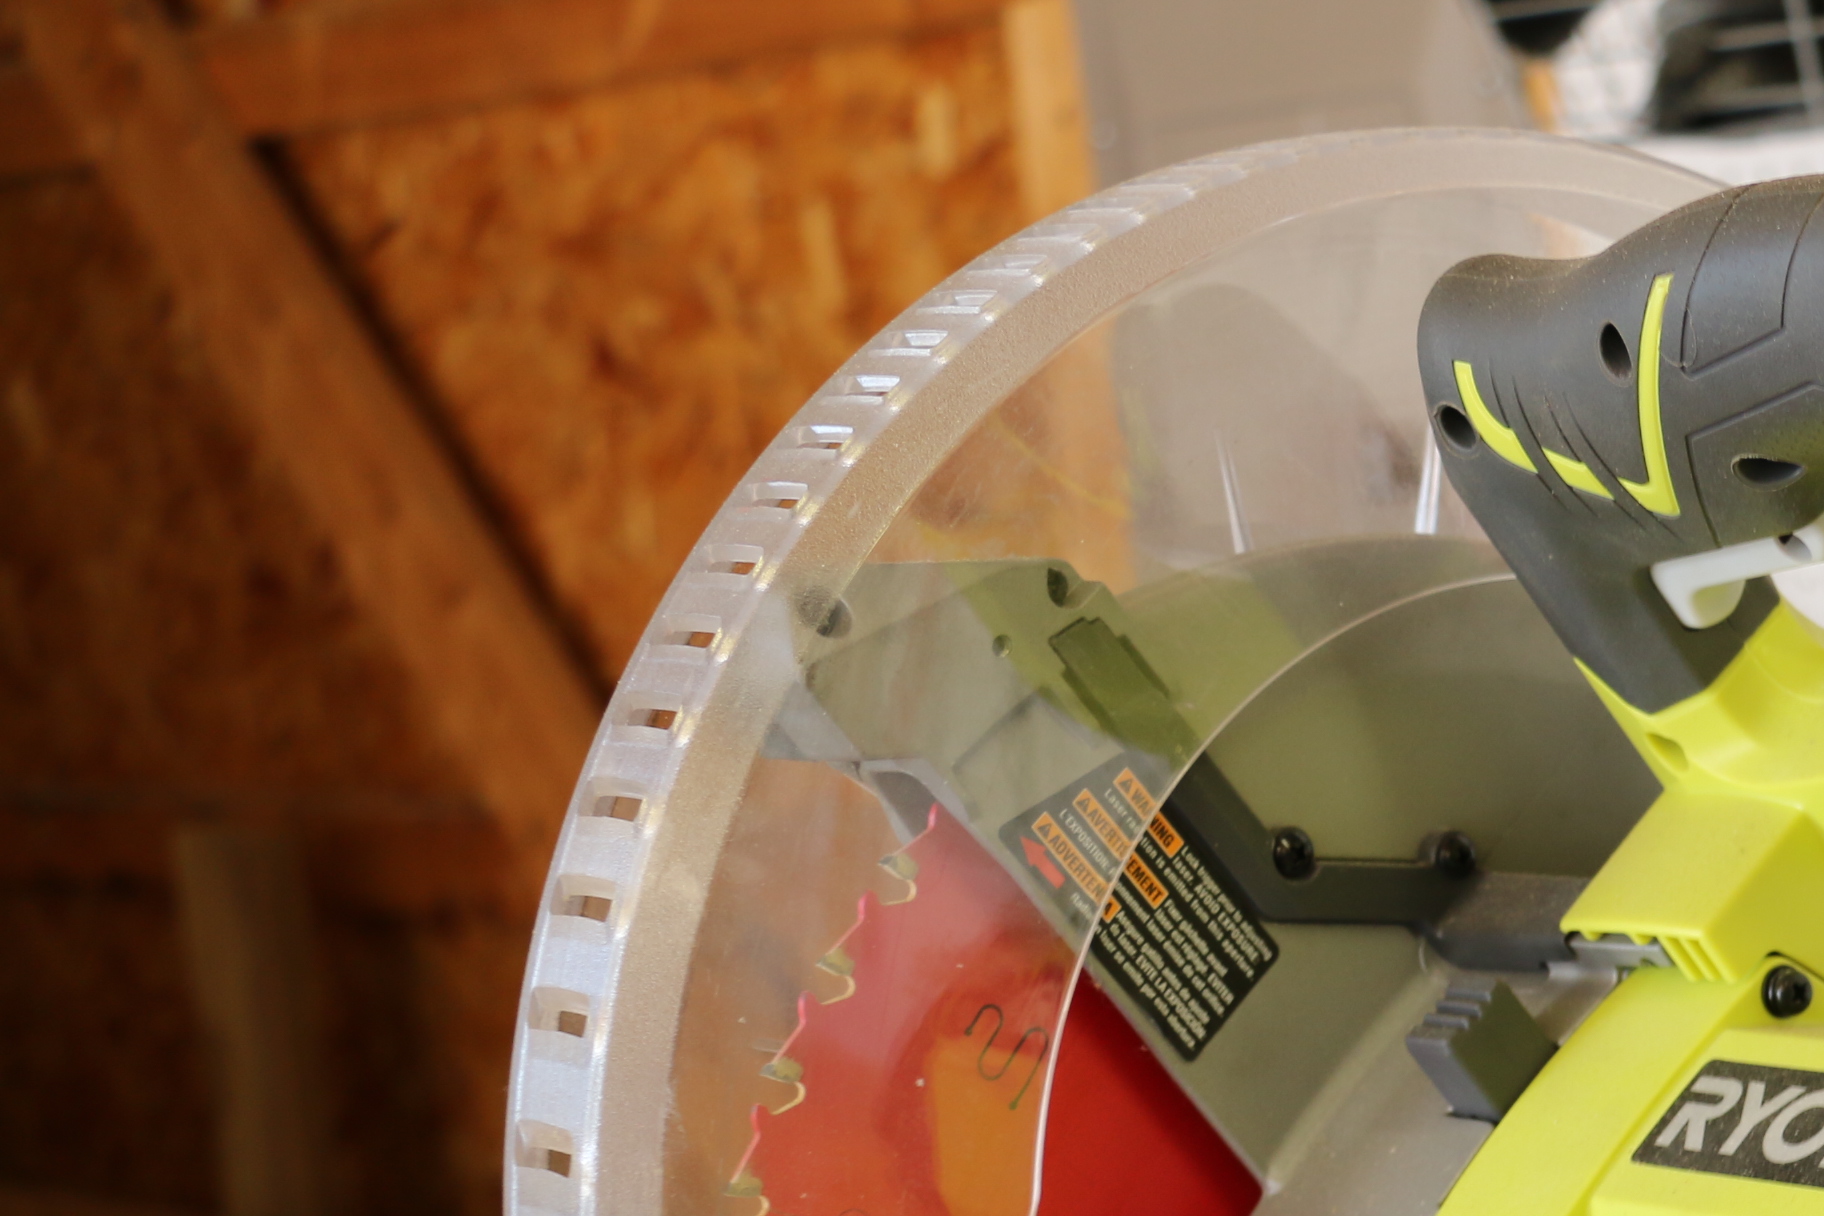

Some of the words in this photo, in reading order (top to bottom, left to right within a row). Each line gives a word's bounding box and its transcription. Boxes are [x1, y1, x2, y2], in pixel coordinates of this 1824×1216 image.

[1131, 789, 1176, 848] WANING
[1049, 835, 1114, 916] ADVERTENA
[1087, 809, 1162, 902] AVERTISEMENT
[1103, 787, 1128, 818] Laser
[1124, 815, 1158, 860] radtion
[1155, 856, 1165, 868] is
[1163, 867, 1193, 902] emitted
[1190, 898, 1209, 923] from
[1207, 920, 1223, 940] this
[1194, 883, 1220, 913] AVOID
[1154, 976, 1167, 992] LA
